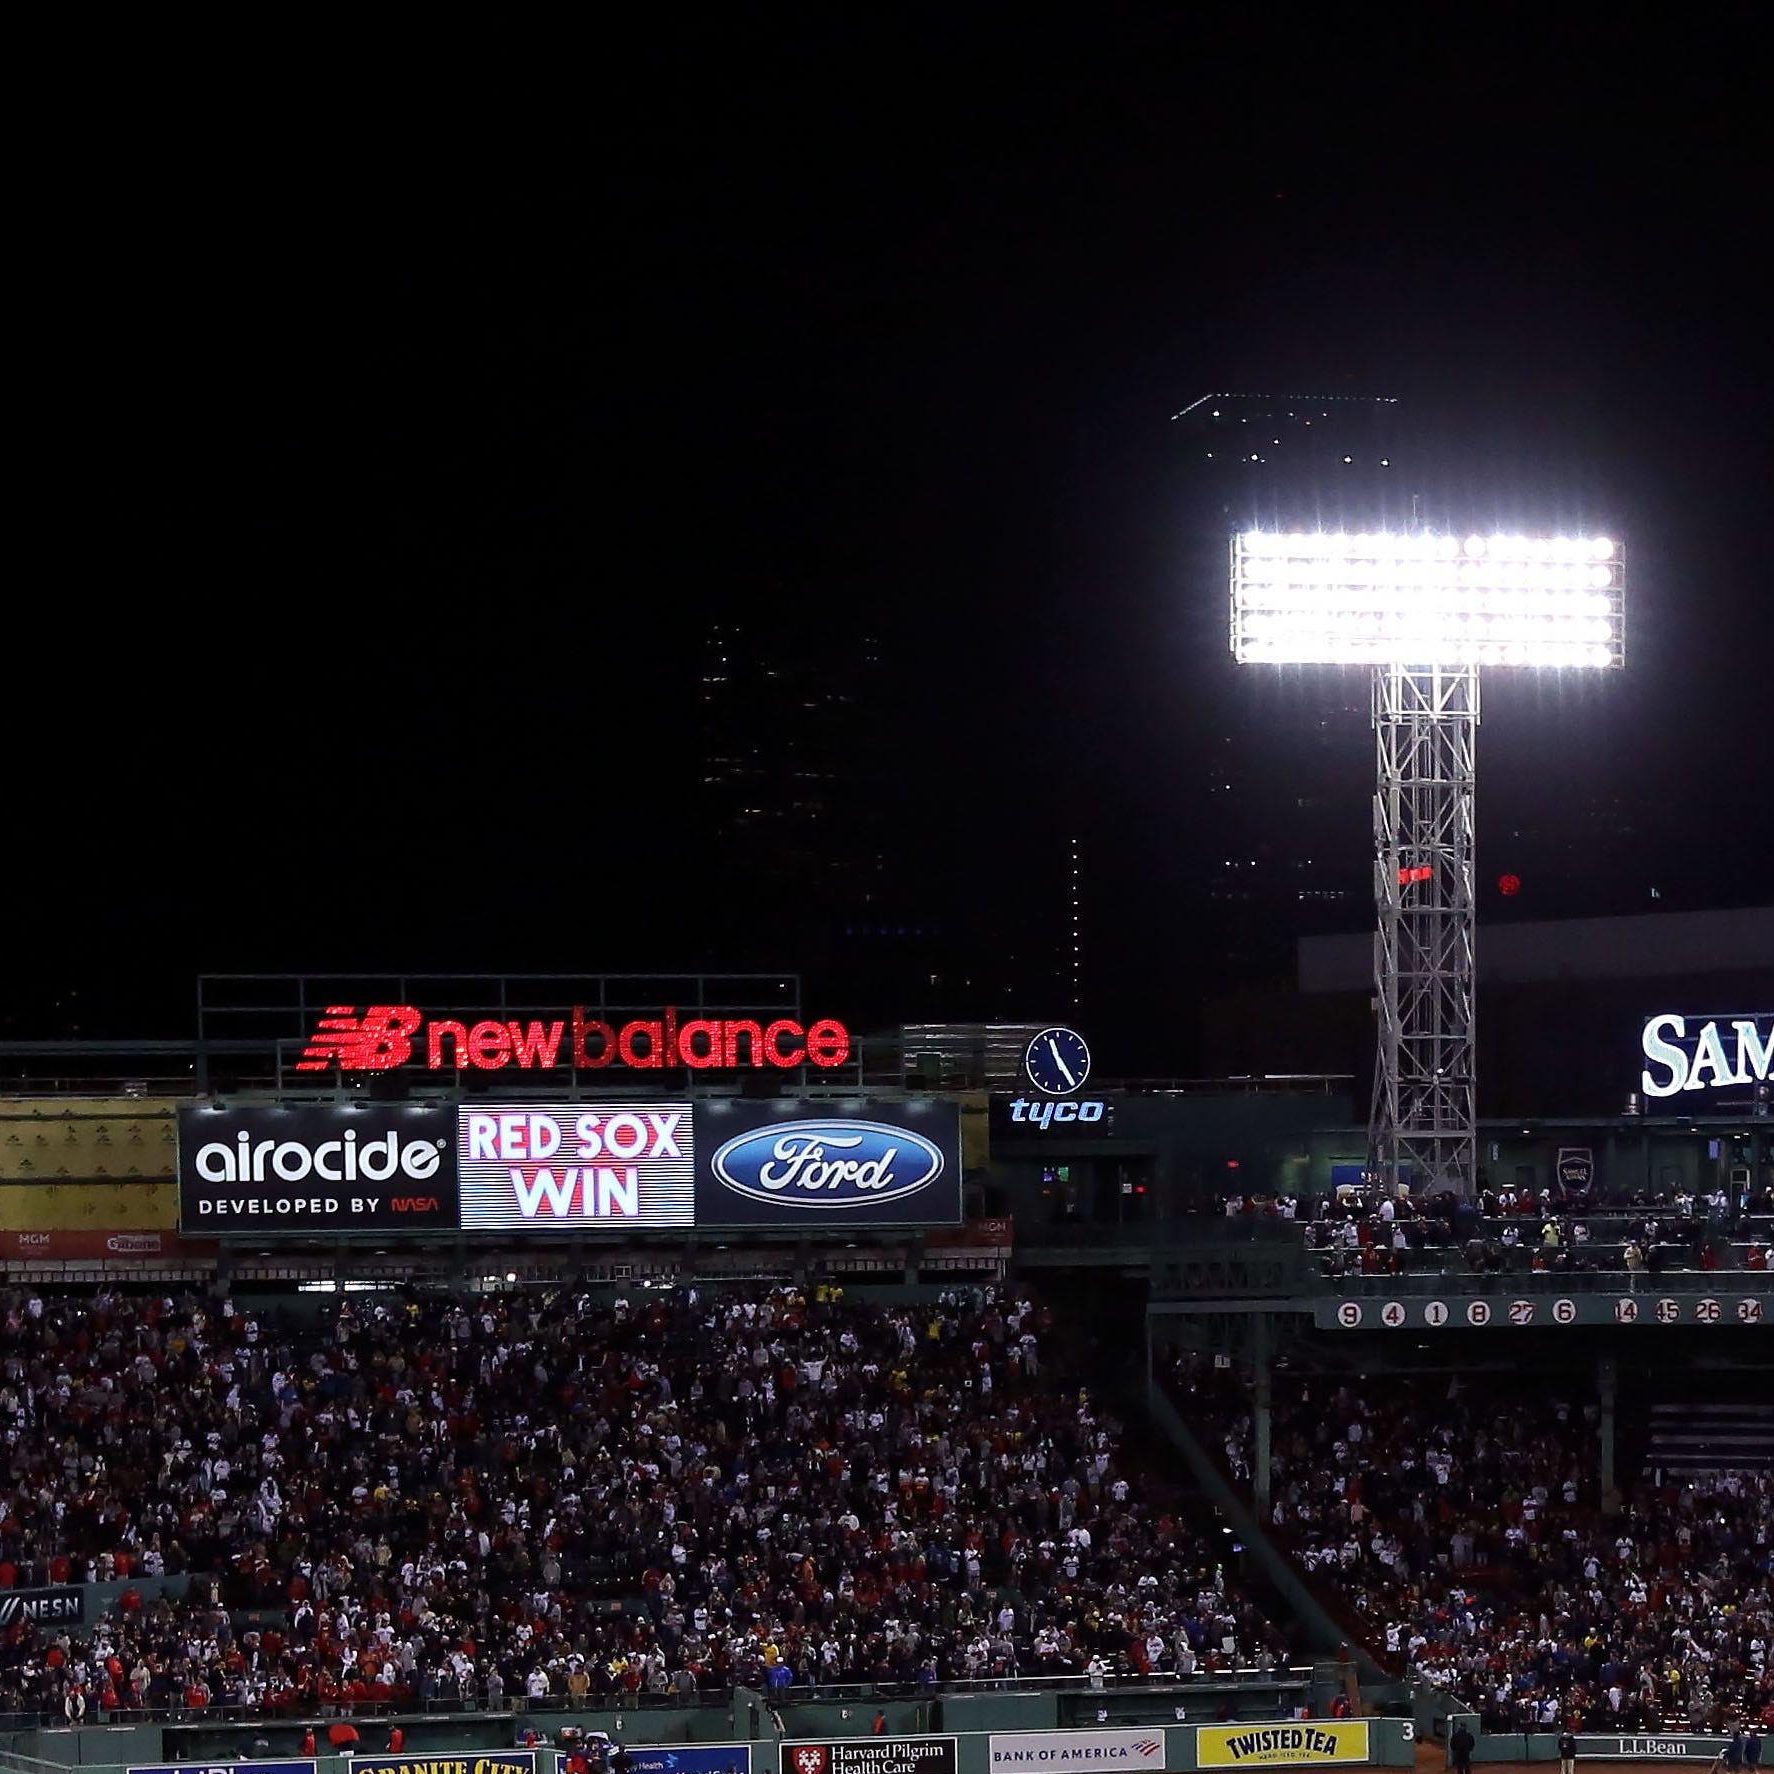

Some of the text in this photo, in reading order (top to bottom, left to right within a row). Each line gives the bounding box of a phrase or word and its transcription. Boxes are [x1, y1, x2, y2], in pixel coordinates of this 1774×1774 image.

[428, 1019, 564, 1068] new
[573, 1005, 850, 1068] balance
[1009, 1098, 1105, 1130] tyco
[468, 1113, 683, 1160] RED SOX
[195, 1129, 441, 1182] airocide
[759, 1131, 898, 1191] Ford
[509, 1166, 639, 1217] WIN
[199, 1198, 438, 1214] DEVELOPED BY NASA
[19, 1234, 50, 1244] MGM
[1344, 1306, 1357, 1324] 9
[1386, 1309, 1399, 1324] 4
[1432, 1305, 1440, 1323] 1
[1472, 1305, 1485, 1322] 8
[1510, 1303, 1536, 1323] 27
[1556, 1302, 1570, 1322] 6
[1616, 1302, 1636, 1320] 14
[1656, 1302, 1680, 1320] 45
[1696, 1302, 1721, 1320] 26
[1739, 1302, 1763, 1320] 34
[23, 1598, 78, 1619] NESN
[1402, 1722, 1415, 1741] 3
[831, 1743, 944, 1763] Harvard Pilgrim
[1226, 1728, 1338, 1760] TWISTED TEA
[1619, 1739, 1687, 1755] L.L.Bean
[994, 1747, 1128, 1763] BANK OF AMERICA
[882, 1759, 916, 1774] Care
